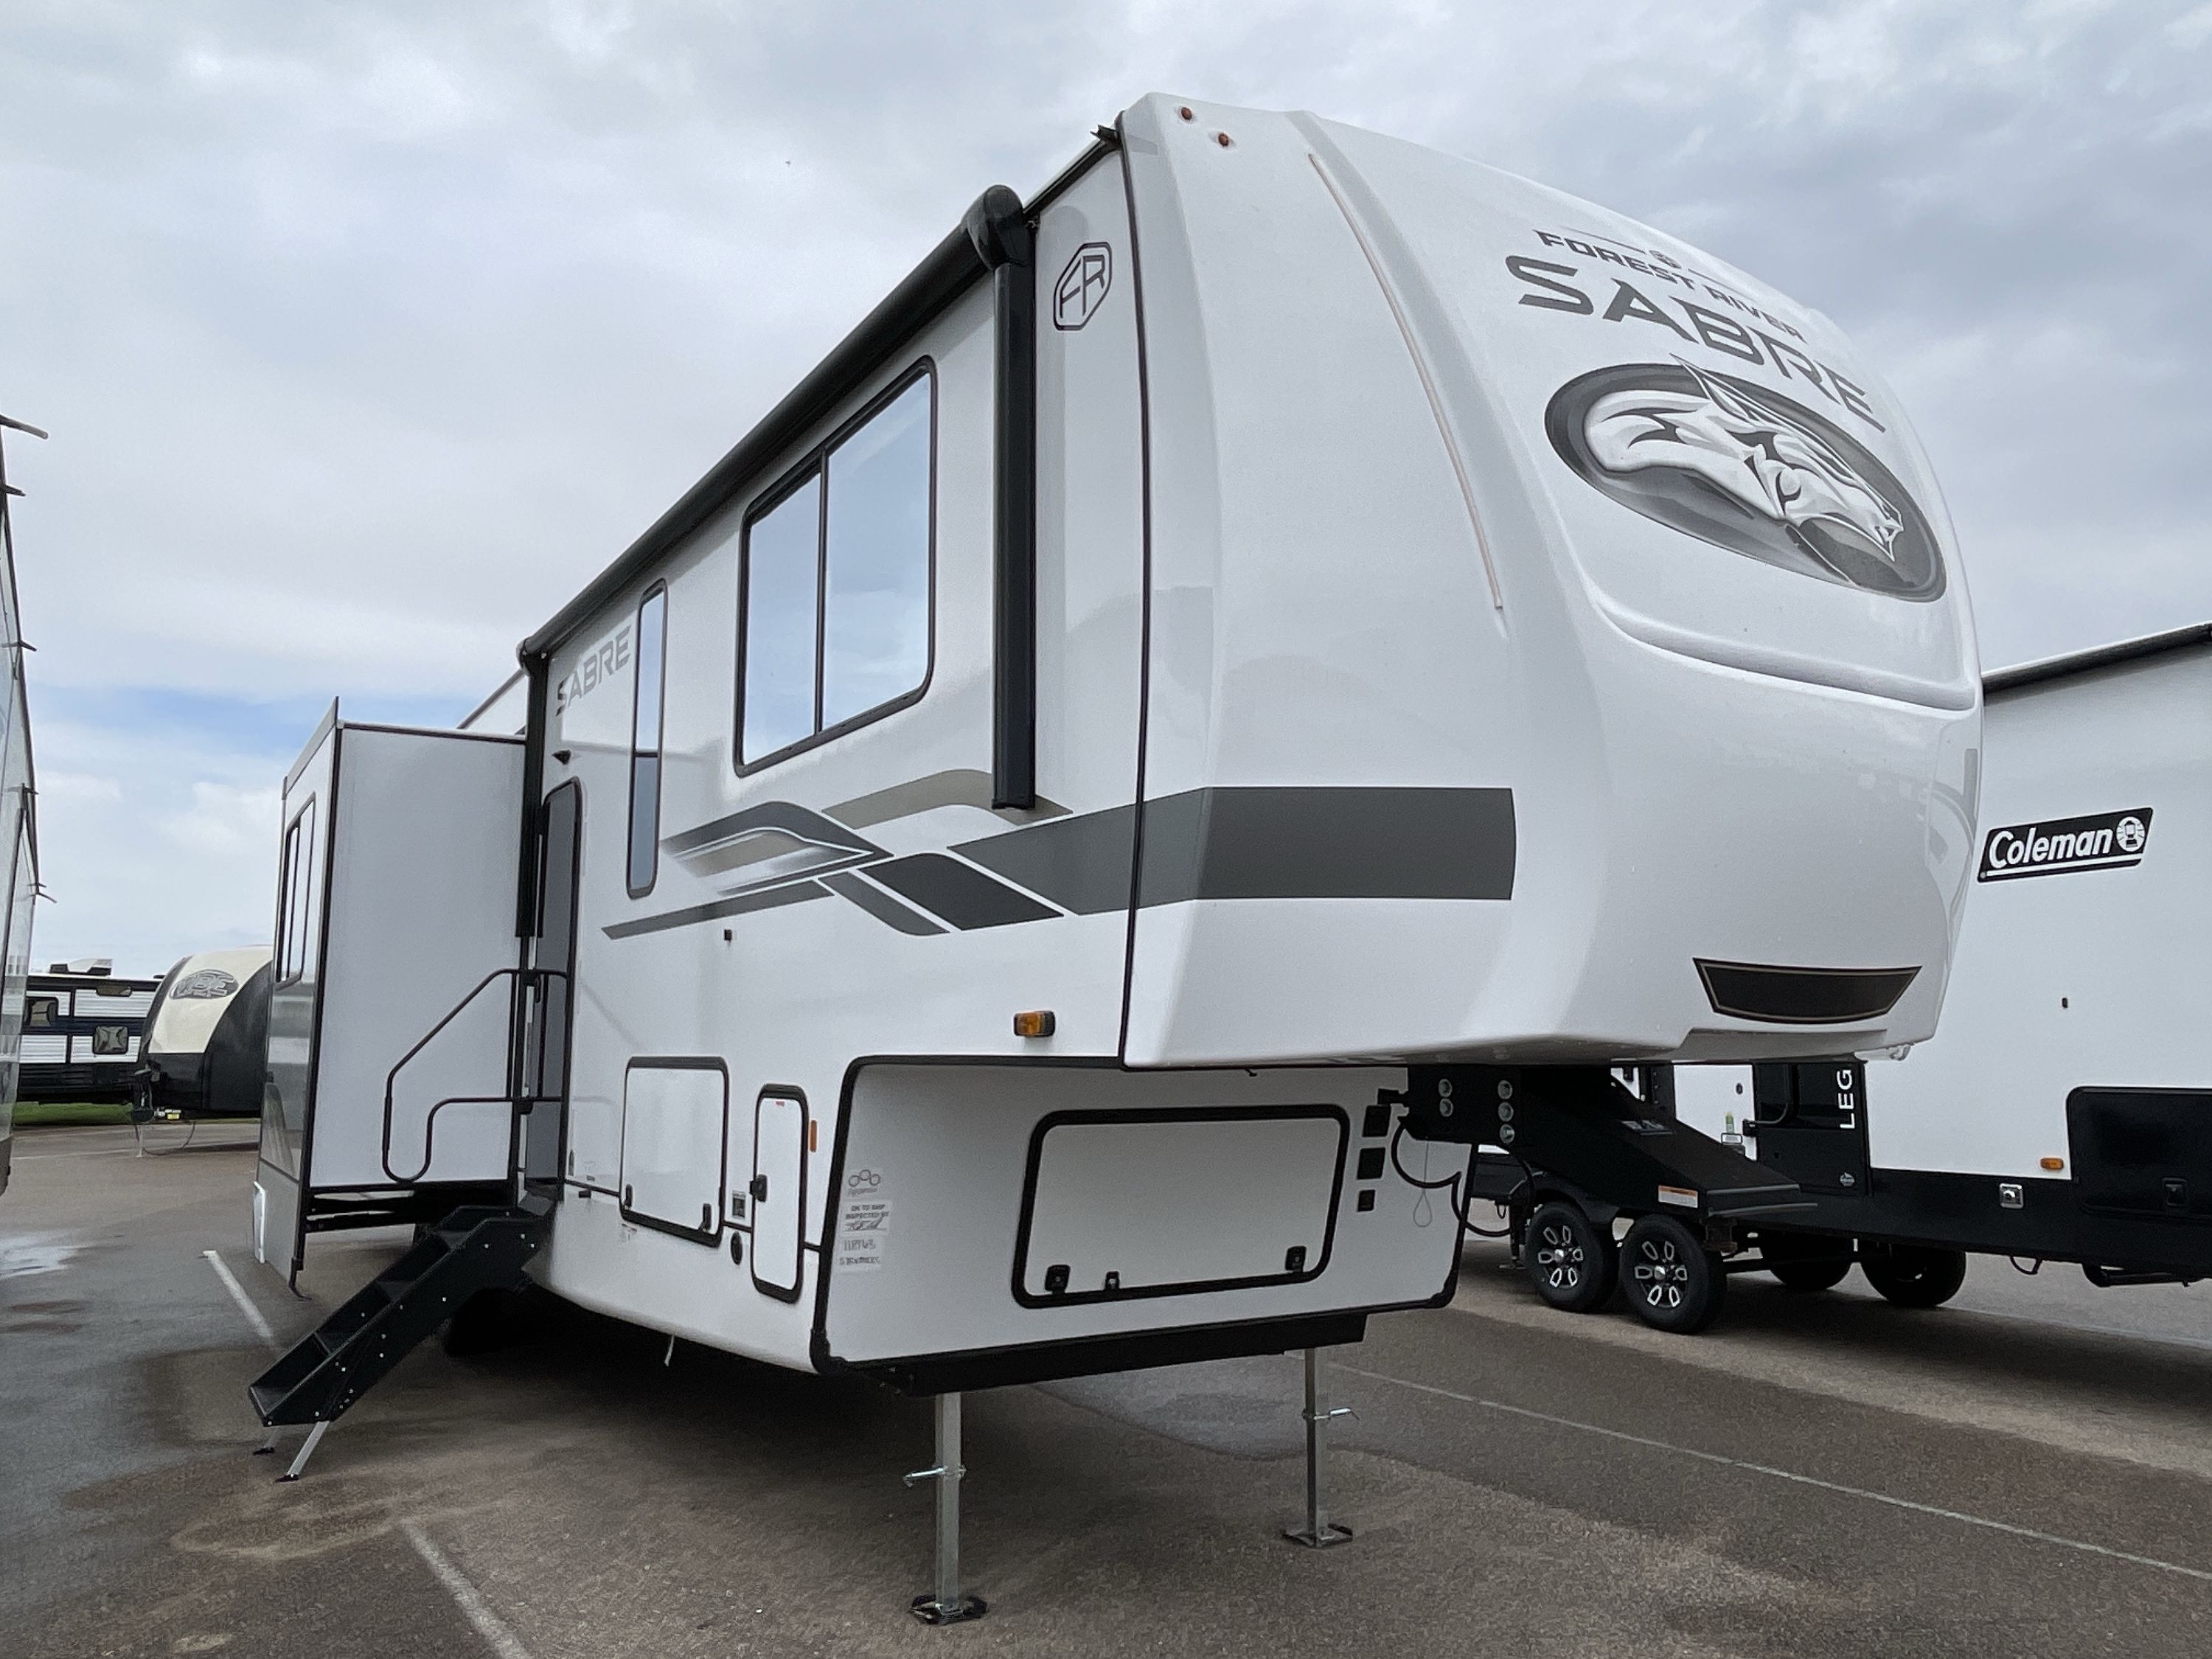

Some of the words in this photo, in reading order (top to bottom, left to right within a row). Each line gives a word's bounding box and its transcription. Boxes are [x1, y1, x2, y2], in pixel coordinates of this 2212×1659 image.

[1533, 229, 1697, 291] FOREST
[1703, 284, 1809, 344] RIVER
[1505, 254, 1886, 433] SABRE
[555, 625, 632, 717] SABRE
[1988, 826, 2114, 869] Coleman
[1836, 1069, 1856, 1130] LEG
